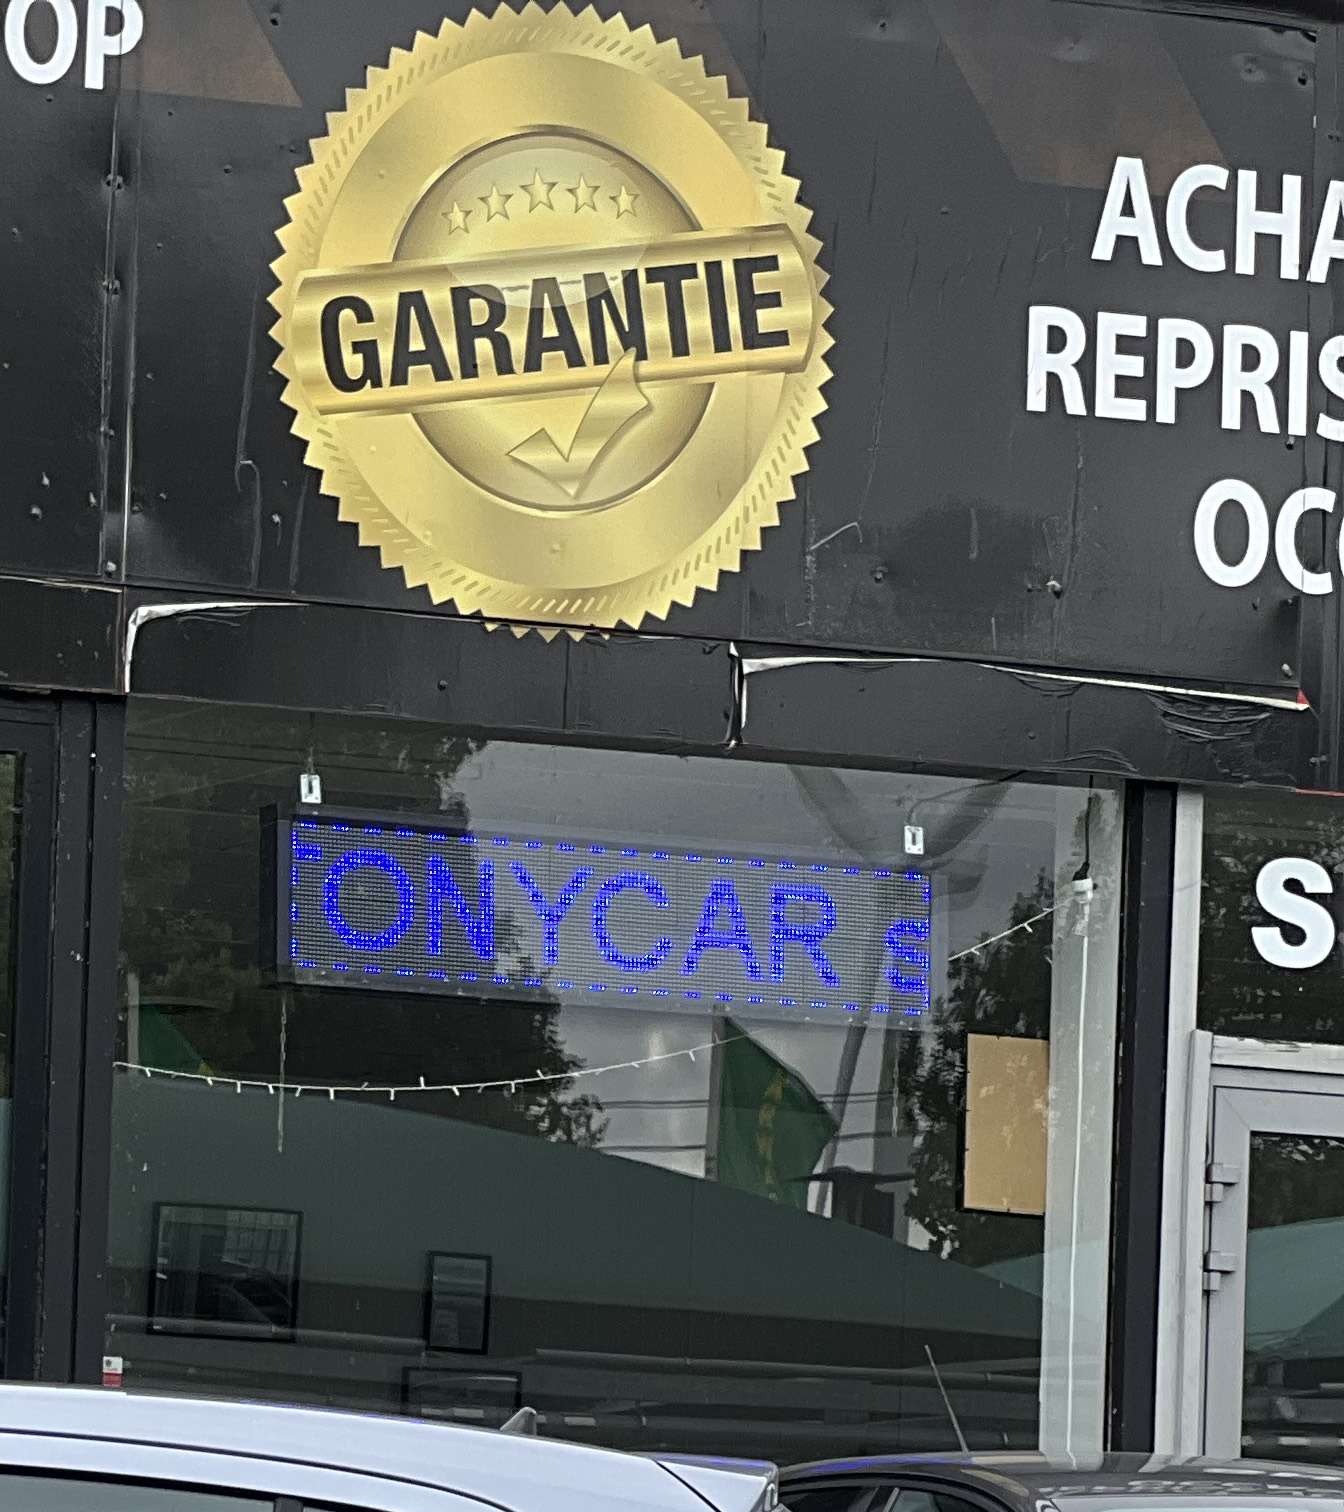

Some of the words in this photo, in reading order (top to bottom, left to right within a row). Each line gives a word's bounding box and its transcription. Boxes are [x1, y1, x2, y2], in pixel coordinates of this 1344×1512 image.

[319, 254, 790, 395] GARANTIE
[293, 840, 841, 988] ONYCAR
[1250, 857, 1336, 969] S
